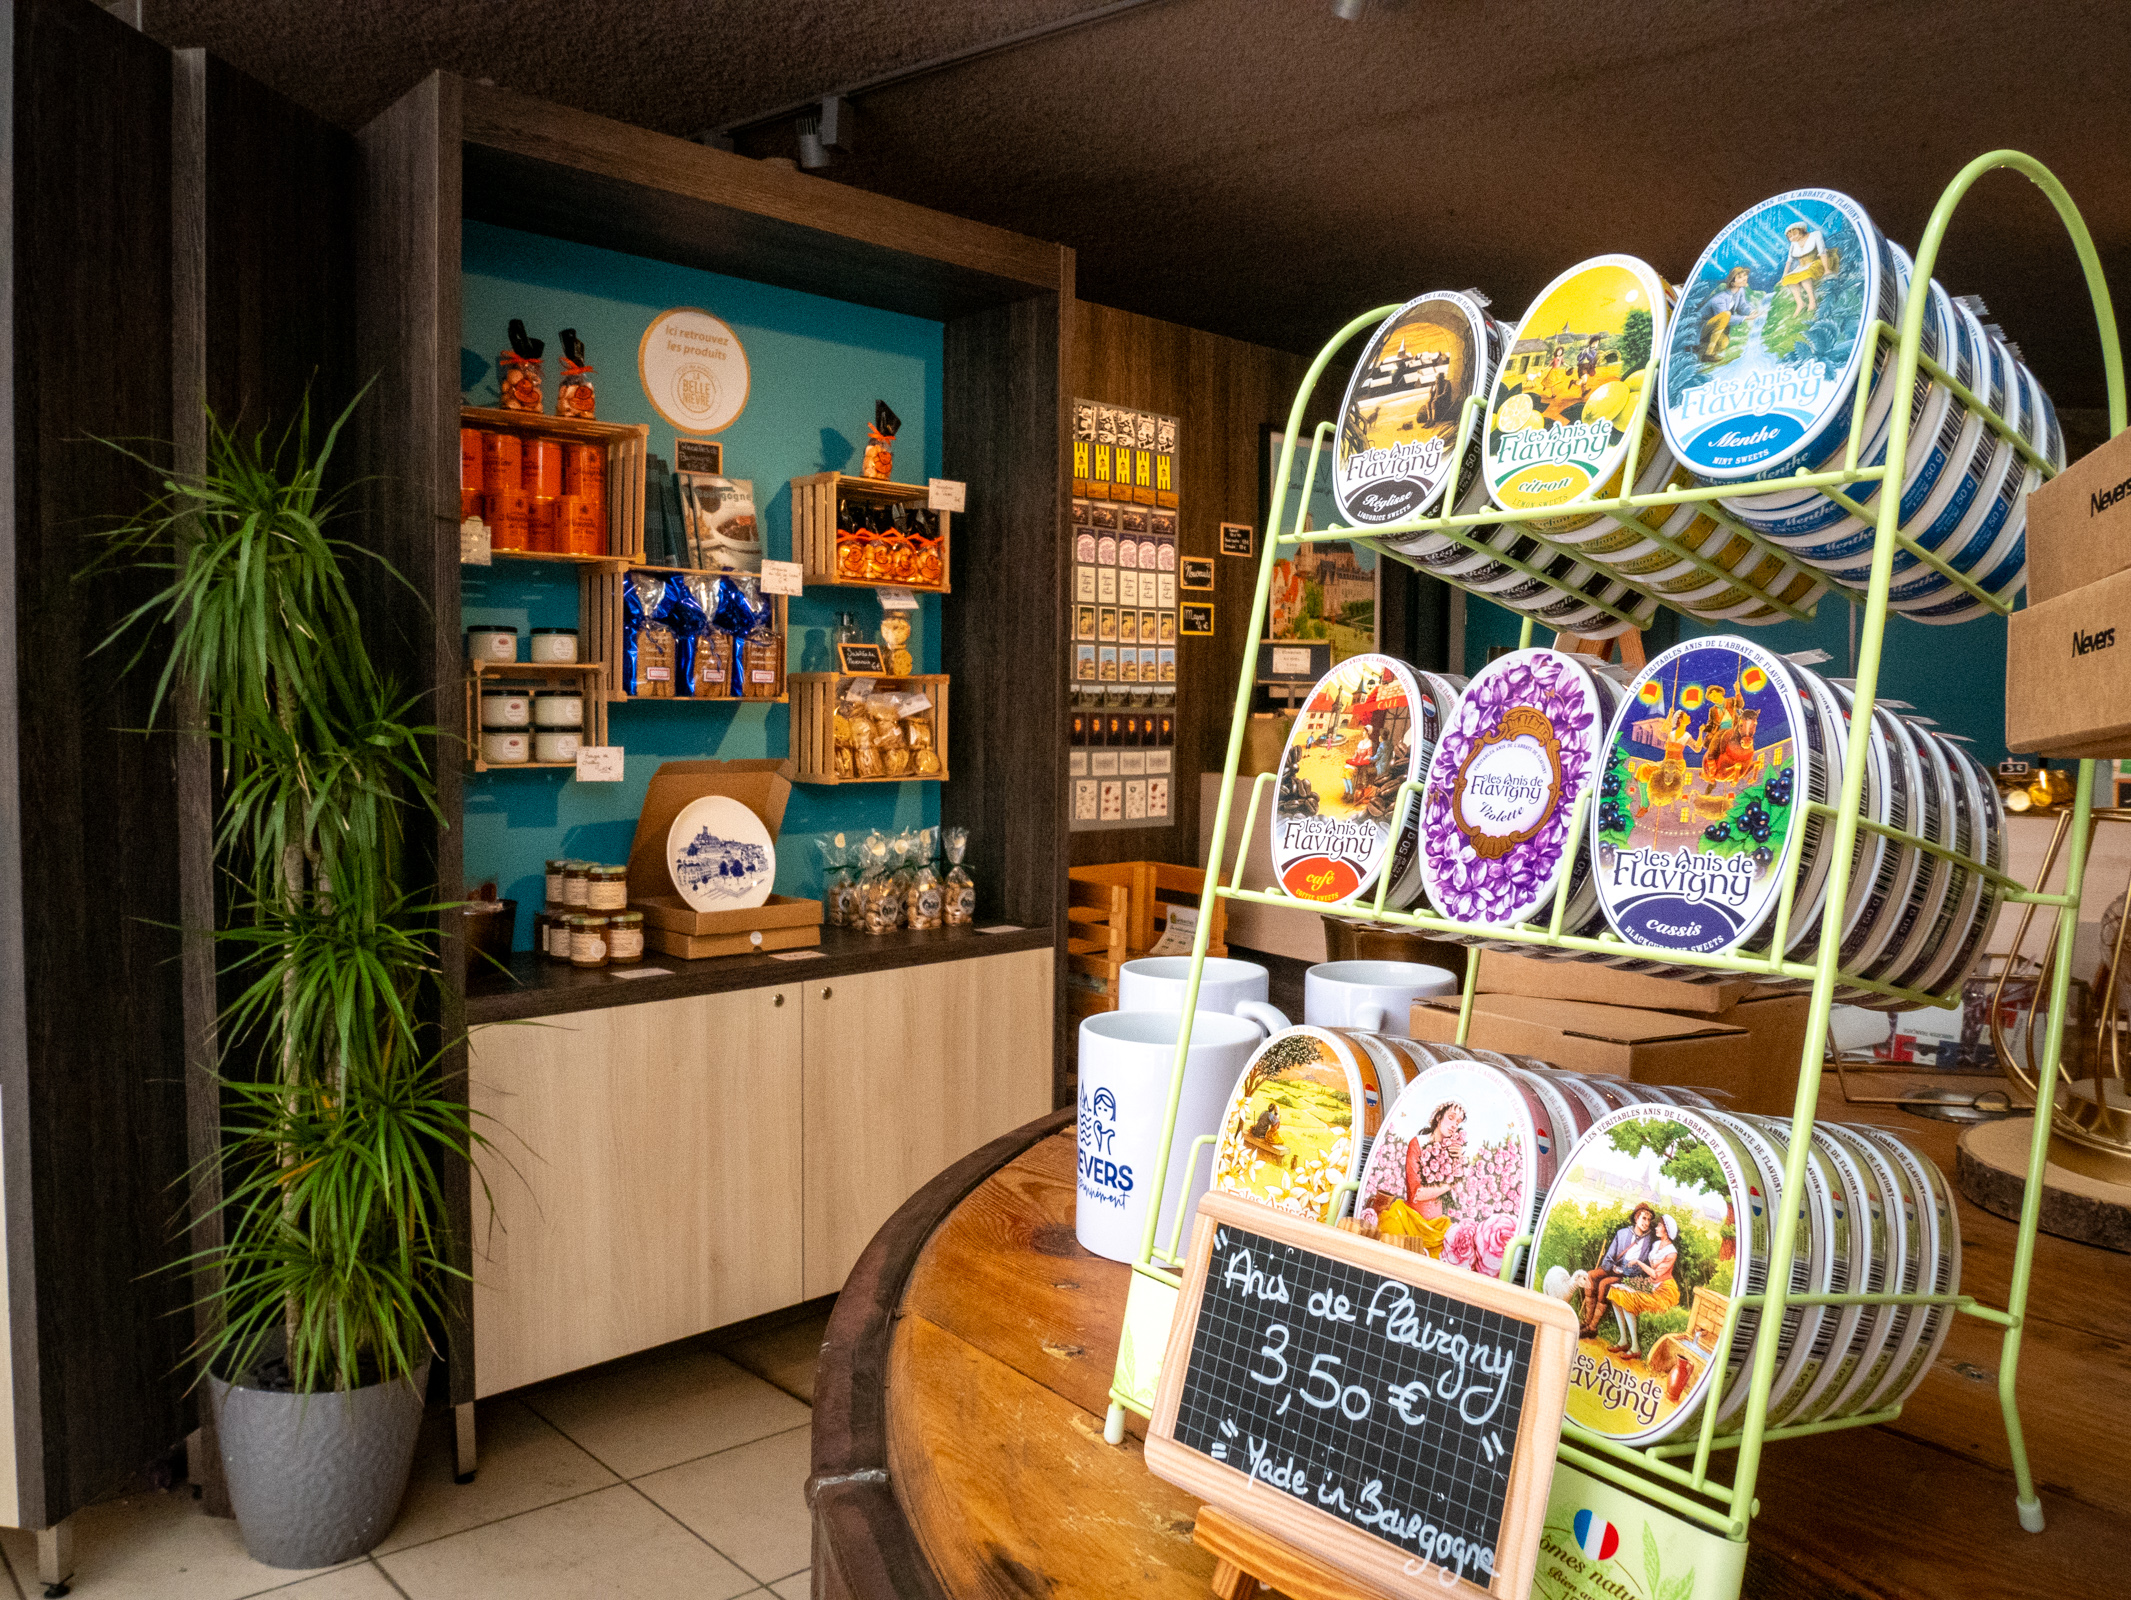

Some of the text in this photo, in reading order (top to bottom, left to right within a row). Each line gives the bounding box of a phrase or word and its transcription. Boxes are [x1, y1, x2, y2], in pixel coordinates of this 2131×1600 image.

[1701, 246, 1714, 260] LES
[1756, 199, 1775, 212] ANIS
[1777, 194, 1788, 202] DE
[1790, 190, 1826, 199] L'ABBAYE
[1826, 192, 1837, 202] DE
[1835, 197, 1861, 222] FLAVIGNY
[665, 324, 729, 347] Ici retrouvez
[667, 340, 727, 362] les produits
[682, 379, 711, 396] BELLE
[1711, 359, 1826, 395] les Anis de
[1681, 377, 1822, 420] Flavigny
[1523, 417, 1612, 443] les Anis de
[1708, 424, 1782, 448] Menthe
[1369, 436, 1444, 462] les Anis de
[1465, 453, 1477, 469] 50
[1498, 432, 1611, 465] Flavigny
[1712, 448, 1770, 466] MINT SWEETS
[1346, 448, 1441, 482] Flavigny
[1754, 450, 1811, 482] Menthe
[1925, 451, 1944, 481] 50 g
[1518, 476, 1570, 493] citron
[1956, 478, 1975, 508] 50 g
[2090, 476, 2131, 518] Nevers
[1357, 503, 1412, 520] LIQUORICE SWEETS
[1363, 489, 1414, 512] Réglisse
[1512, 494, 1568, 508] LEMON SWEETS
[1778, 501, 1838, 528] Menthe
[1987, 510, 1999, 527] 50
[2071, 626, 2116, 658] Nevers
[1631, 680, 1642, 695] LES
[1684, 641, 1703, 651] ANIS
[1717, 640, 1753, 656] L'ABBAYE
[1753, 652, 1764, 664] DE
[1762, 661, 1788, 694] FLAVIGNY
[1470, 775, 1541, 804] Flavigny
[1487, 773, 1544, 787] les Anis de
[1479, 801, 1524, 822] Violette
[1305, 817, 1377, 837] les Anis de
[1283, 823, 1374, 862] Flavigny
[1399, 839, 1411, 857] 50
[1408, 830, 1417, 842] g
[1573, 860, 1585, 877] 50
[1643, 848, 1753, 874] les Anis de
[1306, 870, 1335, 892] café
[1613, 852, 1751, 906] Flavigny
[1296, 888, 1339, 902] COFFEE SWEETS
[1646, 918, 1702, 937] cassis
[1863, 910, 1874, 925] 50
[1690, 935, 1725, 953] SWEETS
[1585, 1132, 1597, 1144] LES
[1643, 1107, 1661, 1115] ANIS
[1664, 1109, 1674, 1118] DE
[1677, 1113, 1711, 1139] L'ABBAYE
[1709, 1138, 1720, 1151] DE
[1717, 1150, 1739, 1190] FLAVIGNY
[1754, 1143, 1783, 1193] DE FLAVIGNY
[1831, 1149, 1859, 1196] DE FLAVIGNY
[1867, 1152, 1895, 1198] DE FLAVIGNY
[1898, 1151, 1927, 1195] DE FLAVIGNY
[1225, 1248, 1289, 1305] Anis
[1308, 1287, 1357, 1322] de
[1250, 1323, 1431, 1426] 3,50 €
[1598, 1357, 1637, 1390] Anis
[1640, 1377, 1663, 1401] de
[1317, 1472, 1351, 1514] in
[1354, 1479, 1501, 1588] Bourgogne
[1547, 1566, 1578, 1592] Bien
